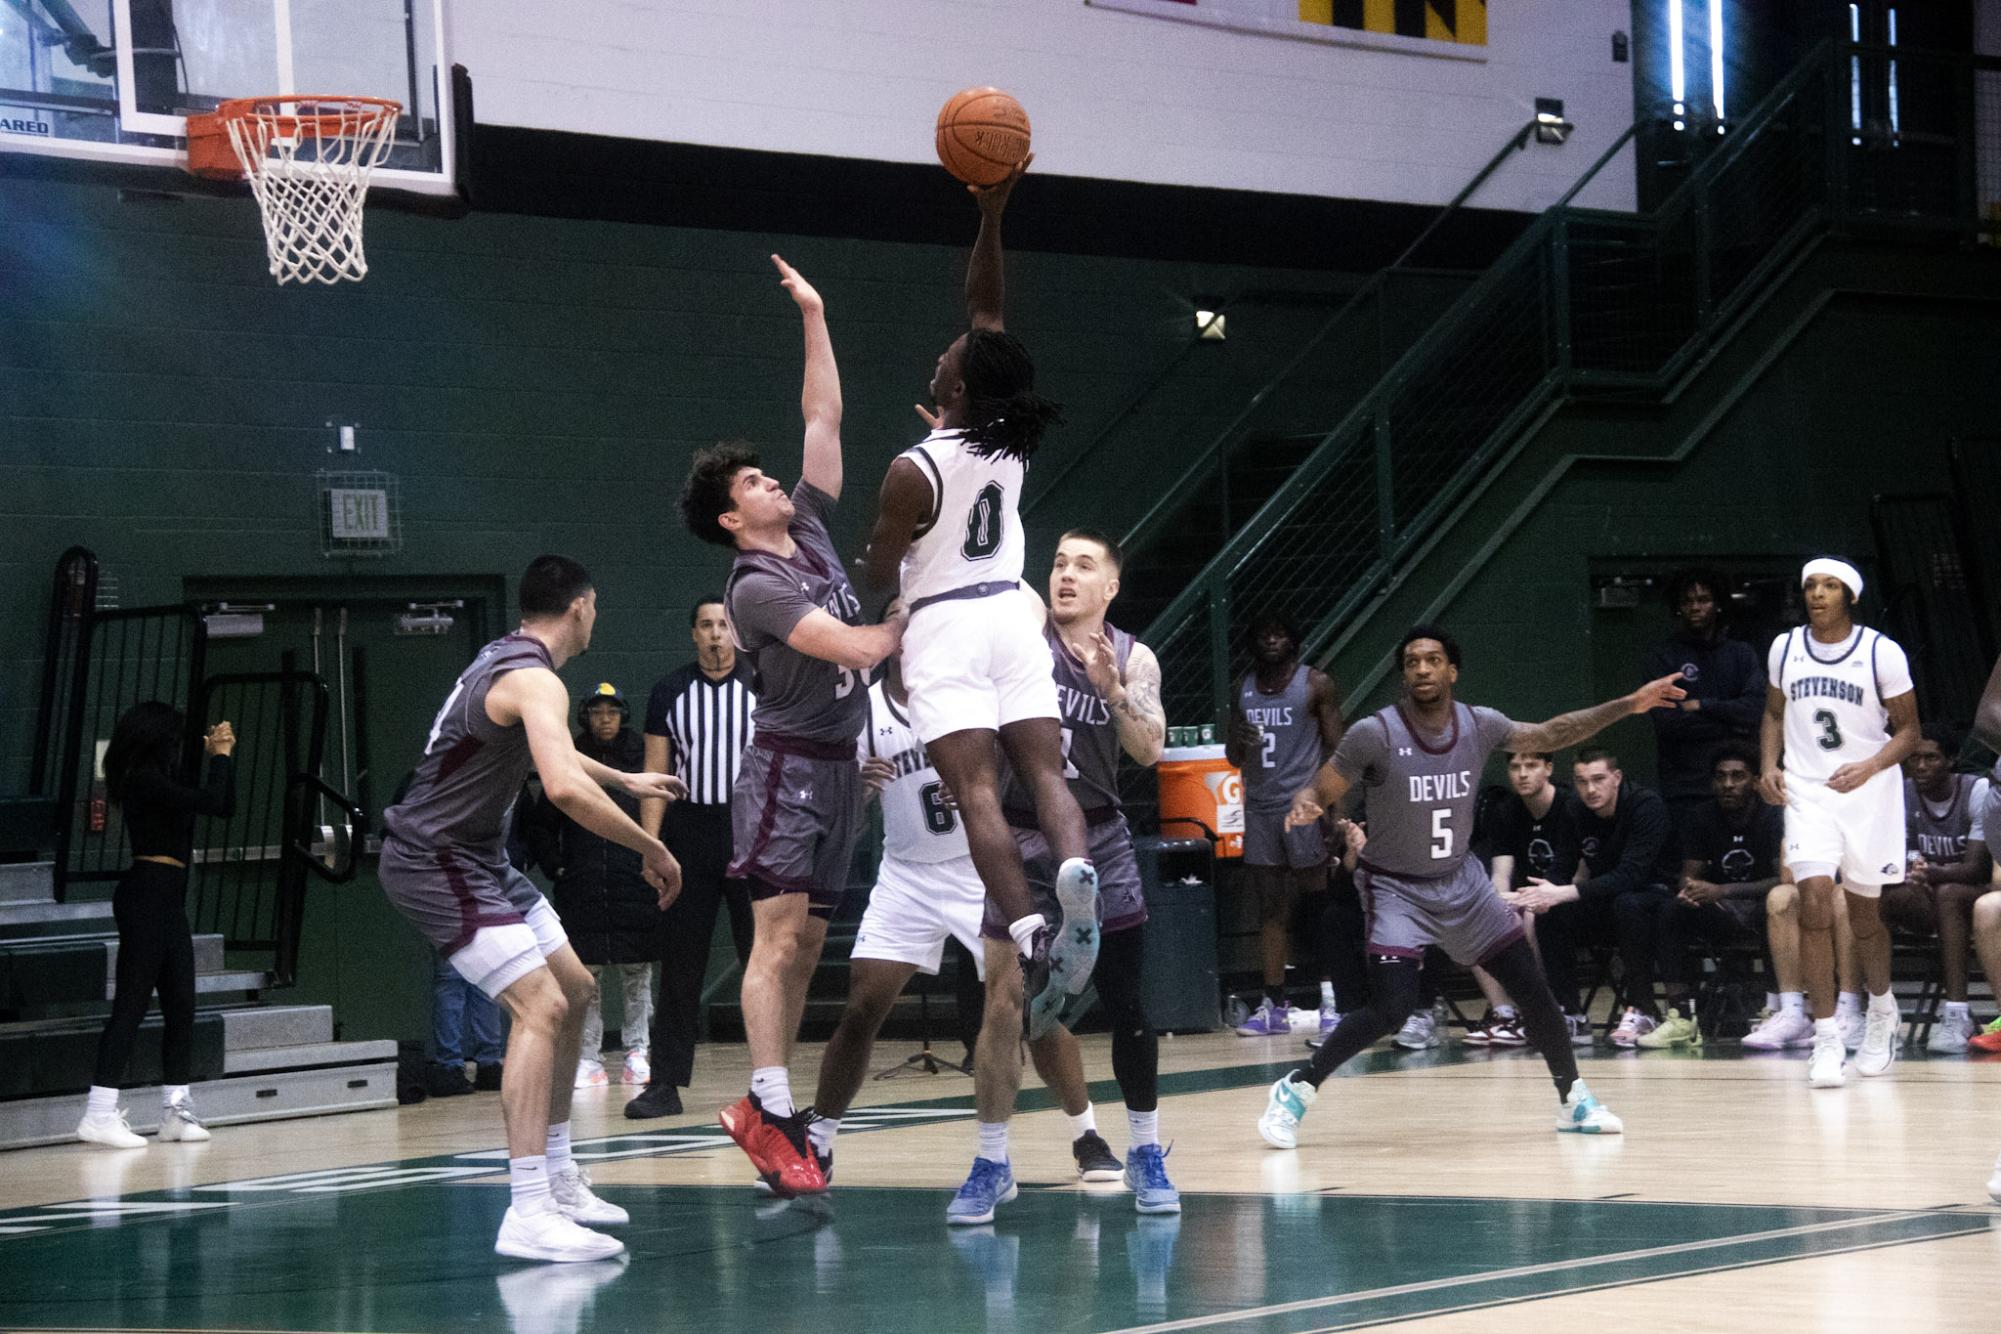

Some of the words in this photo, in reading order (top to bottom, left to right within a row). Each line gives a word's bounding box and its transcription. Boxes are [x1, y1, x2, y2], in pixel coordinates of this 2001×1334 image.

[343, 494, 378, 530] EXIT
[960, 480, 1005, 562] 0
[1790, 676, 1864, 707] STEVENSON
[1246, 707, 1293, 727] DEVILS
[1813, 708, 1845, 752] 3
[1261, 732, 1276, 768] 2
[1408, 770, 1471, 802] DEVILS
[1430, 808, 1454, 859] 5
[1917, 833, 1968, 857] DEVILS
